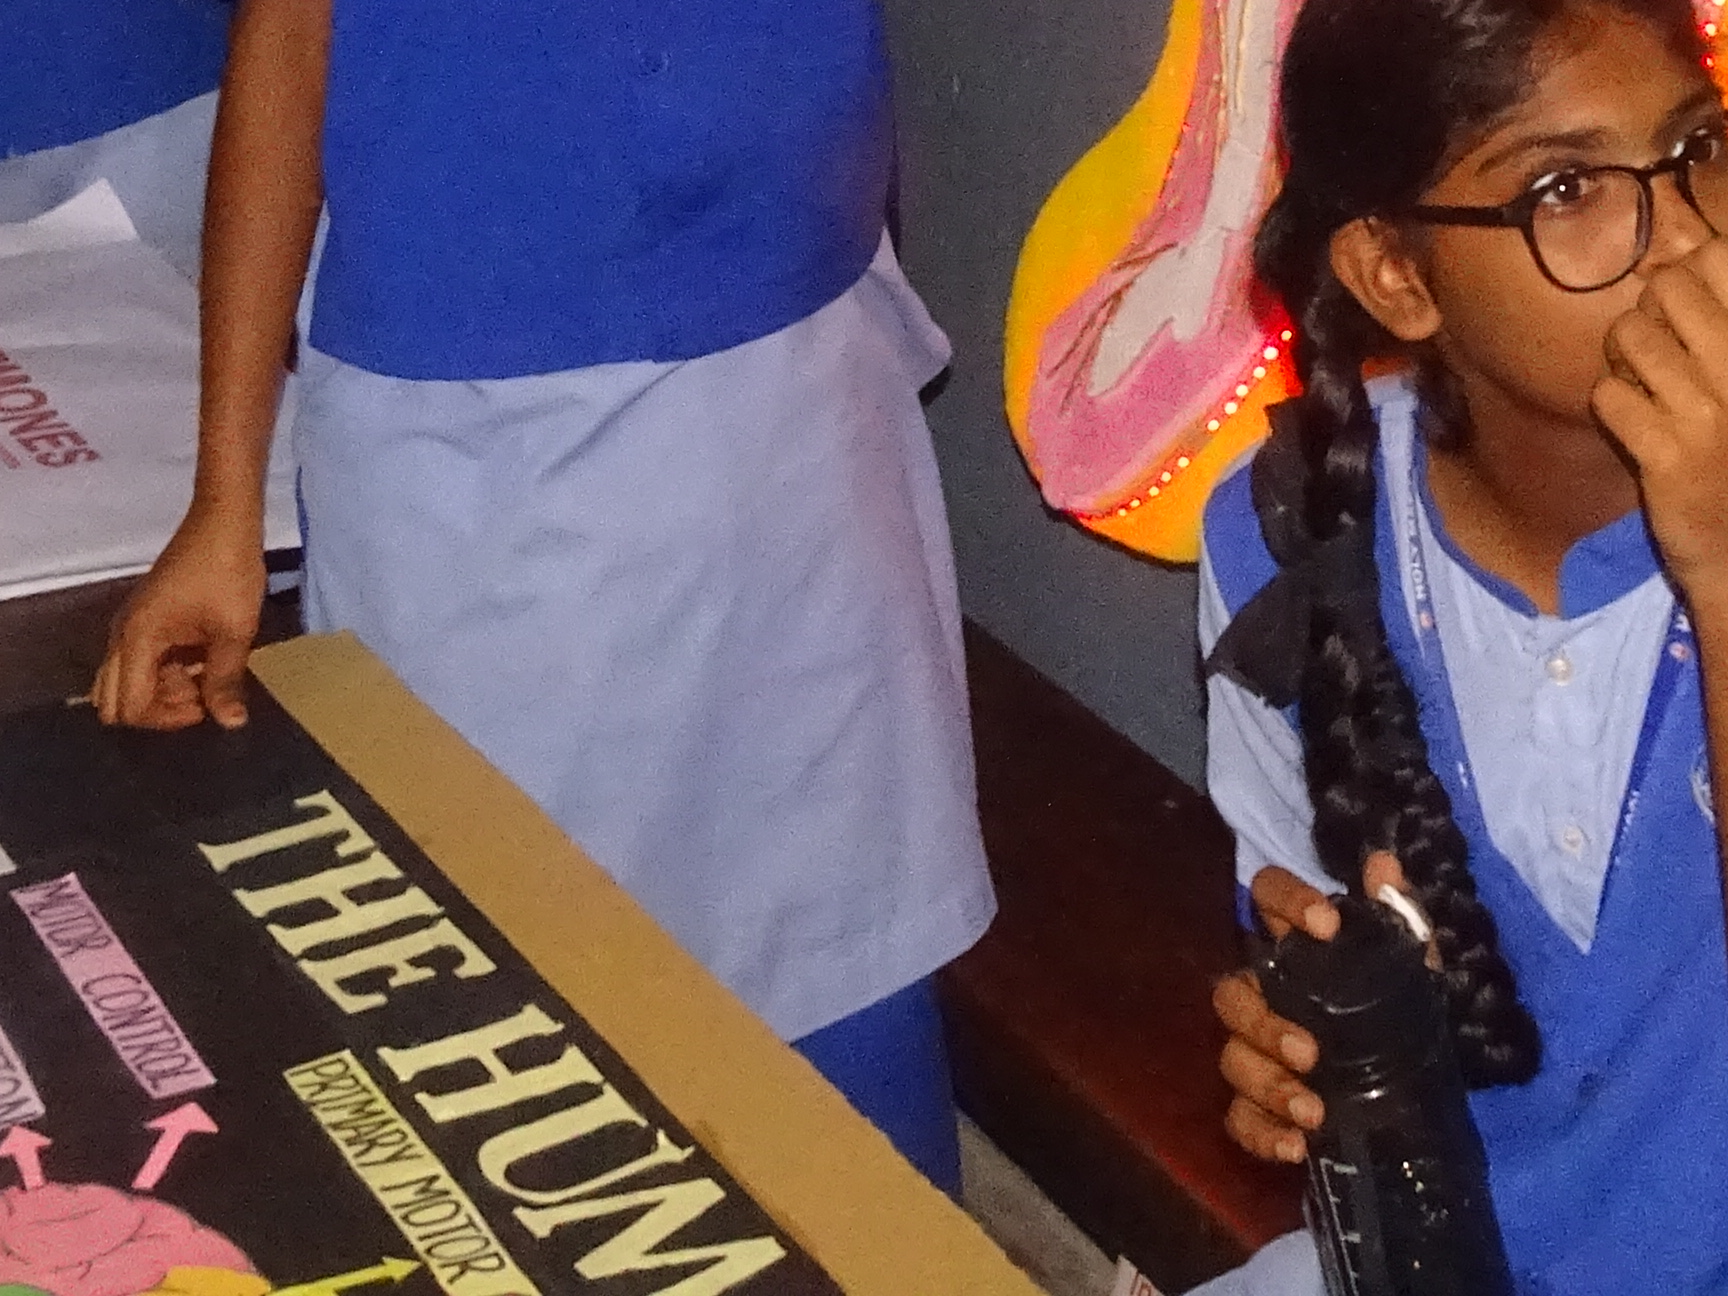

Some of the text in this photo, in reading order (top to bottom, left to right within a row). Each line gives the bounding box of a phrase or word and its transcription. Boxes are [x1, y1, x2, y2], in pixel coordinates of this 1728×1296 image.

[25, 877, 200, 1094] MOTOR CONTROL
[196, 788, 498, 1014] THE
[289, 1054, 506, 1286] PRIMARY MOTOR
